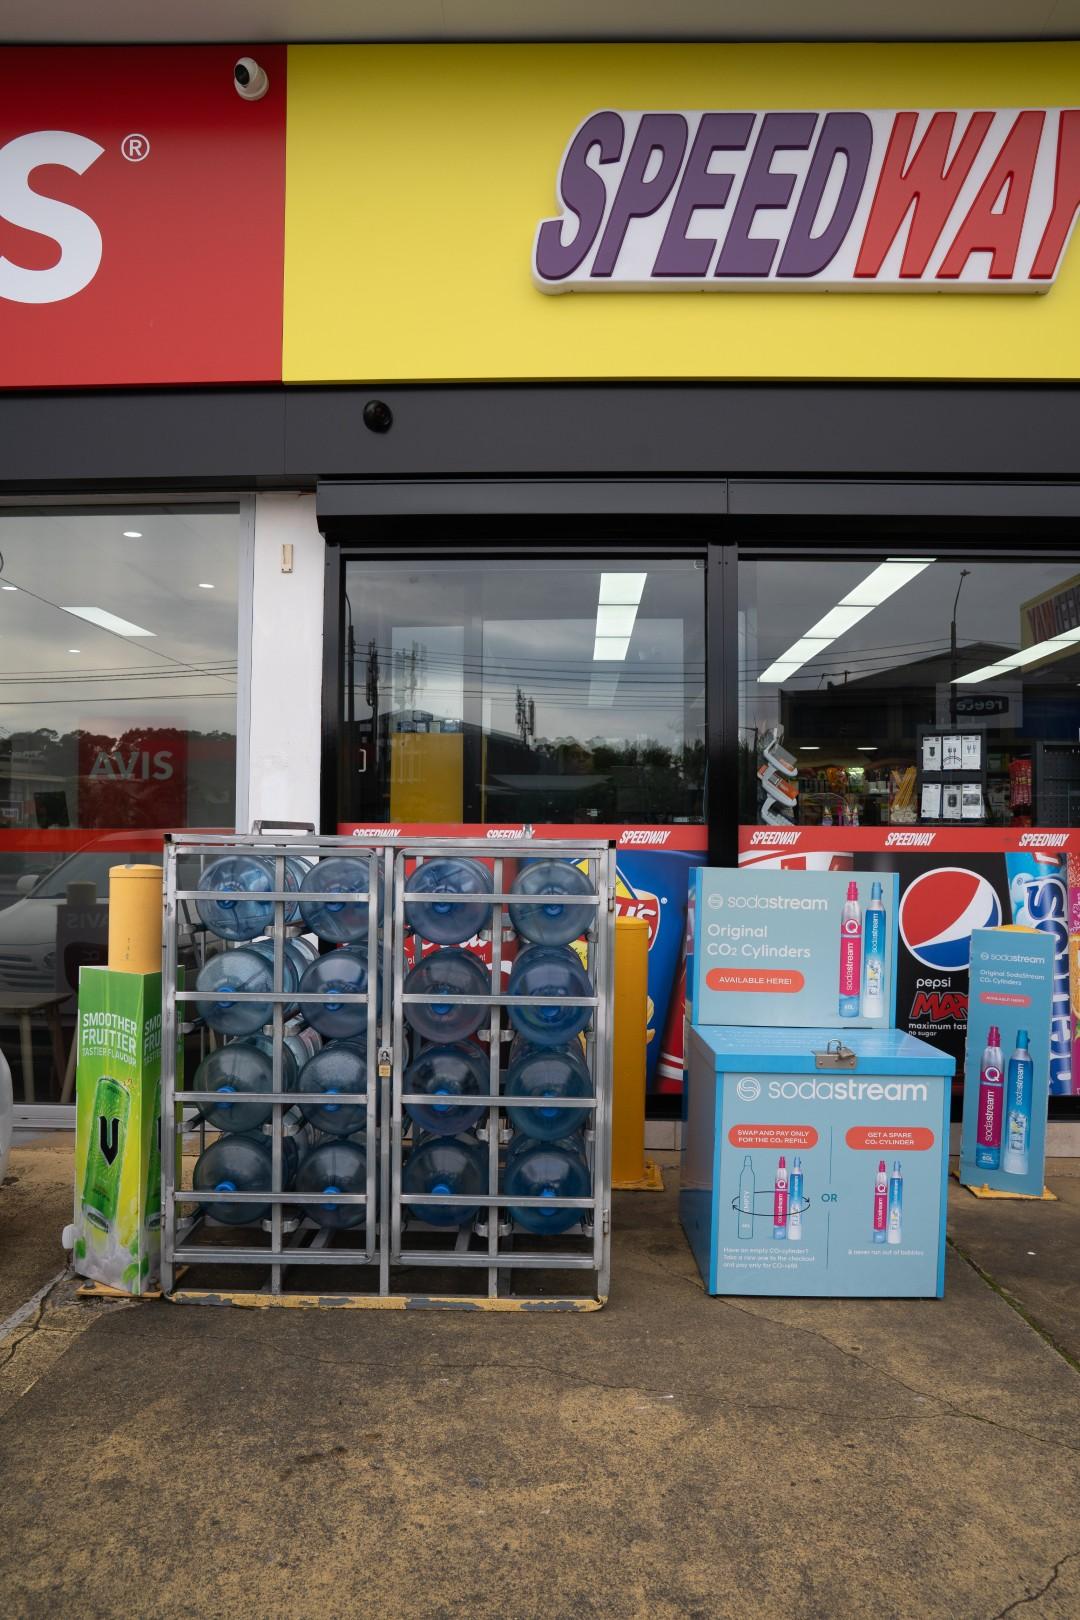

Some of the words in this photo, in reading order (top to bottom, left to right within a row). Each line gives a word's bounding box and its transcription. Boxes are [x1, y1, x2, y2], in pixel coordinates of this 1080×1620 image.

[534, 109, 1080, 281] SPEEDWAY
[88, 750, 174, 780] AVIS
[619, 830, 671, 844] SPEEDWAY
[750, 831, 802, 845] SPEEDWAY
[884, 832, 936, 847] SPEEDWAY
[1018, 833, 1070, 847] SPEEDWAY
[727, 895, 829, 911] sodastream
[707, 923, 768, 940] Original
[845, 919, 858, 933] Q
[741, 943, 811, 959] Cylinders
[846, 942, 854, 991] sodastream
[990, 953, 1045, 965] sodastream
[719, 976, 765, 984] AVAILABLE
[979, 969, 1005, 977] Original
[916, 977, 952, 990] pepsi
[992, 977, 1022, 986] Cylinders
[82, 1013, 137, 1037] SMOOTHER
[908, 1022, 951, 1030] maximum
[82, 1028, 137, 1056] FRUITIER
[984, 1066, 1000, 1082] Q
[768, 1078, 928, 1101] sodastream
[1016, 1063, 1024, 1105] sodastream
[985, 1090, 995, 1142] sodastream
[821, 1193, 839, 1203] OR
